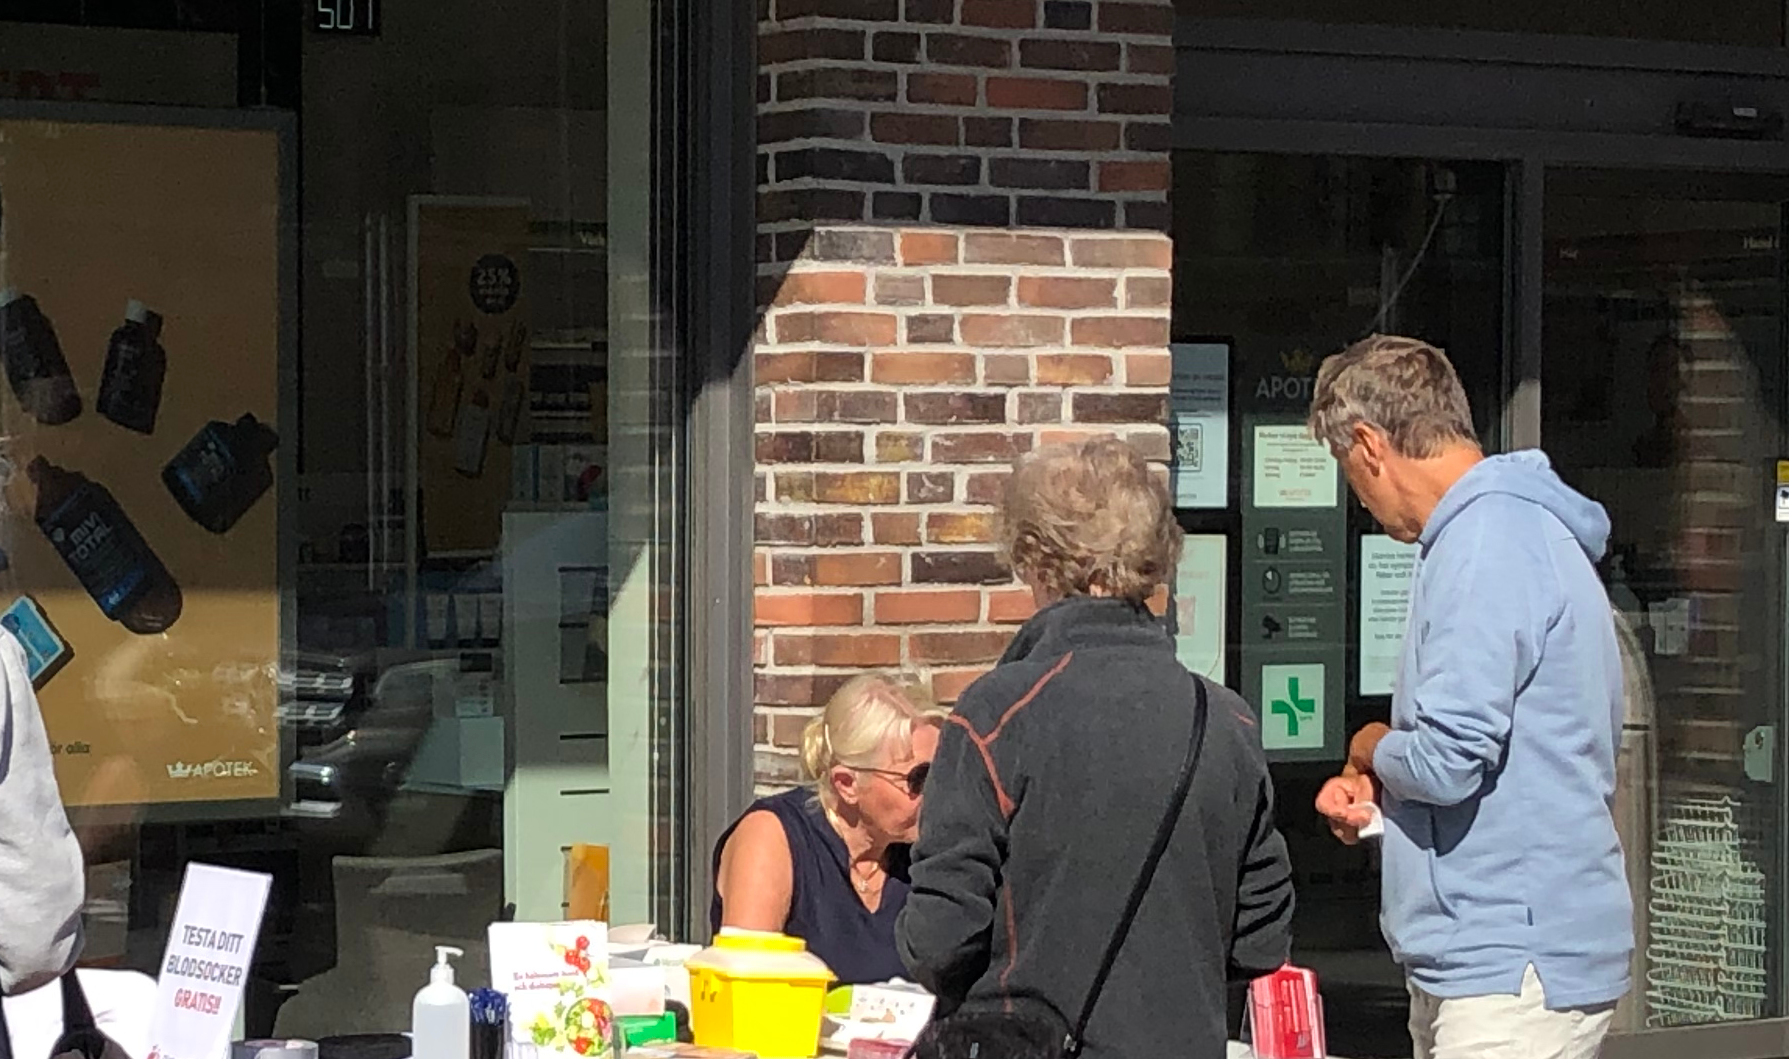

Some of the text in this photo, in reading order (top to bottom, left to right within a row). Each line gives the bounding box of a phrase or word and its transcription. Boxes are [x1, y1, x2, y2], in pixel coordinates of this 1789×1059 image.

[1255, 377, 1313, 399] APOT
[192, 761, 258, 778] APOTEK
[182, 925, 244, 954] TESTA DITT
[166, 954, 243, 986] BLODSOCKER
